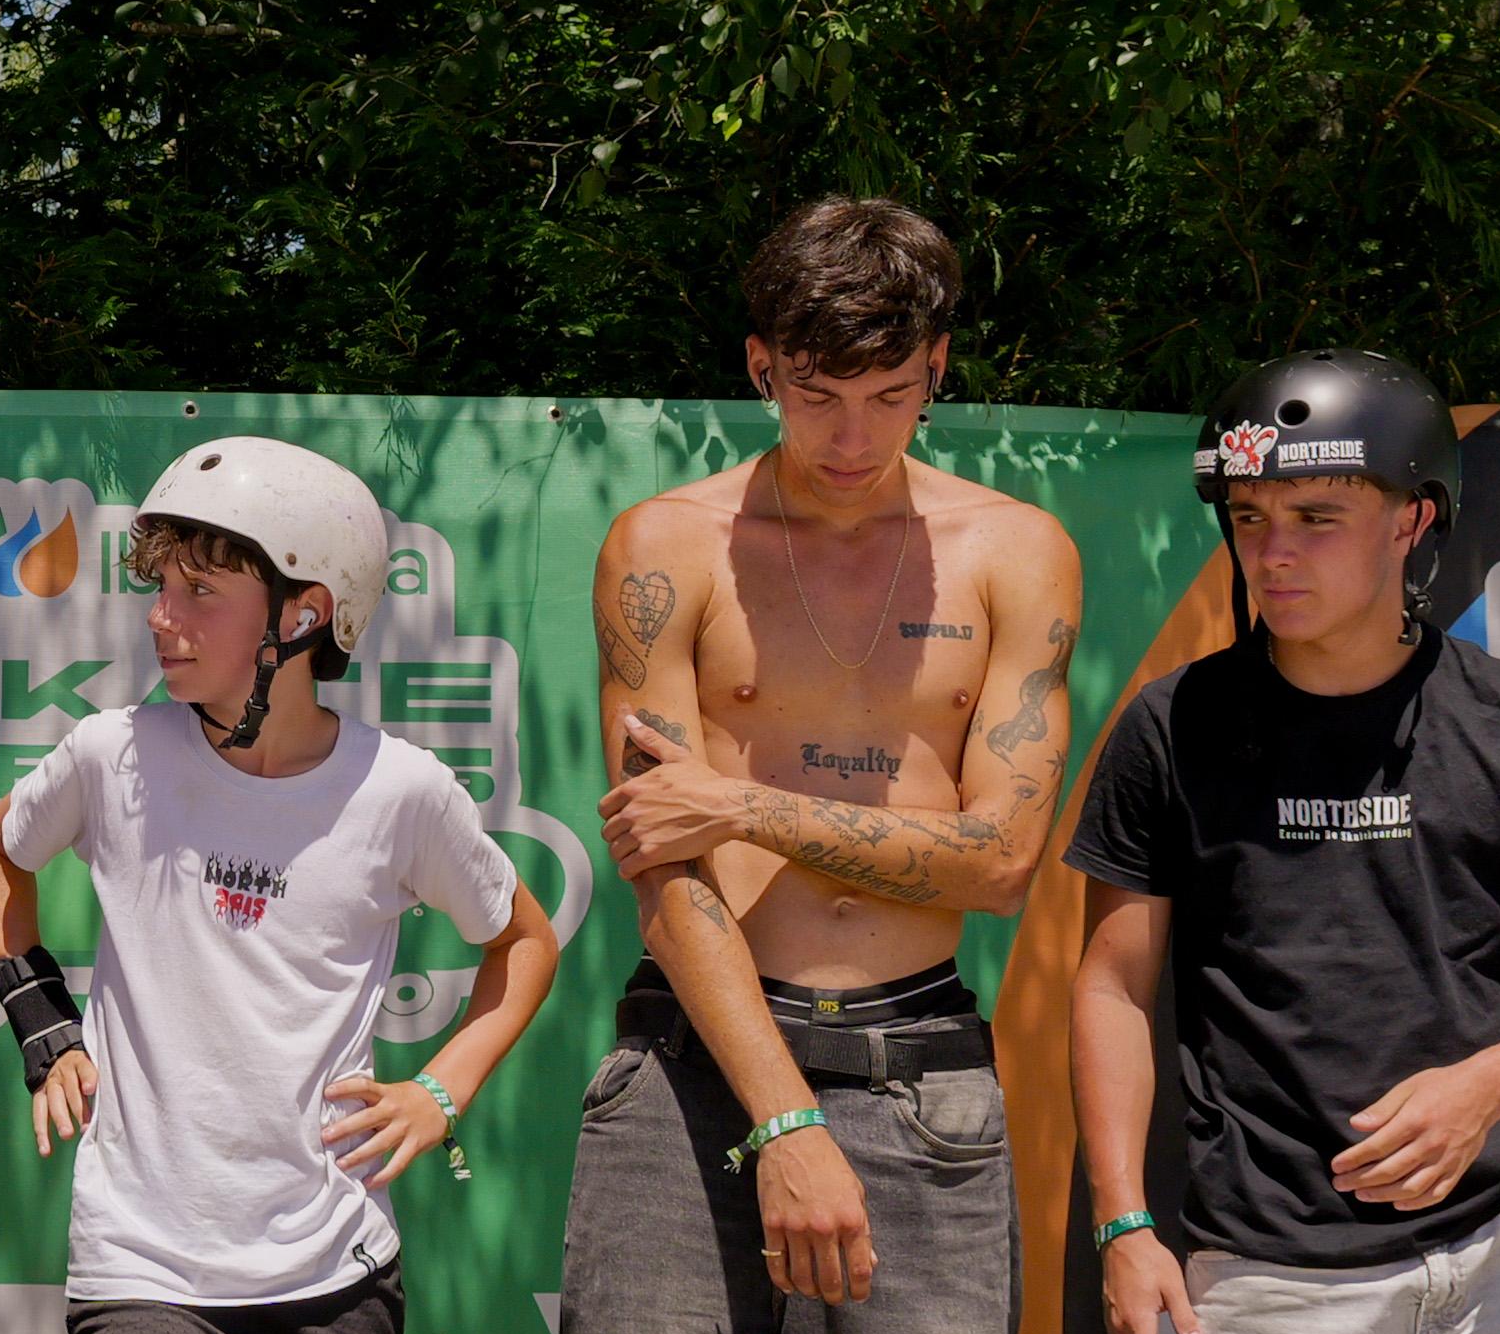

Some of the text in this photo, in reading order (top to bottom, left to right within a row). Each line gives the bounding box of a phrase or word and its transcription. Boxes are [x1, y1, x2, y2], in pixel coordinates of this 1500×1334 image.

[1278, 441, 1364, 462] NORTHSIDE
[800, 743, 902, 782] Loyalty
[1277, 793, 1412, 829] NORTHSIDE
